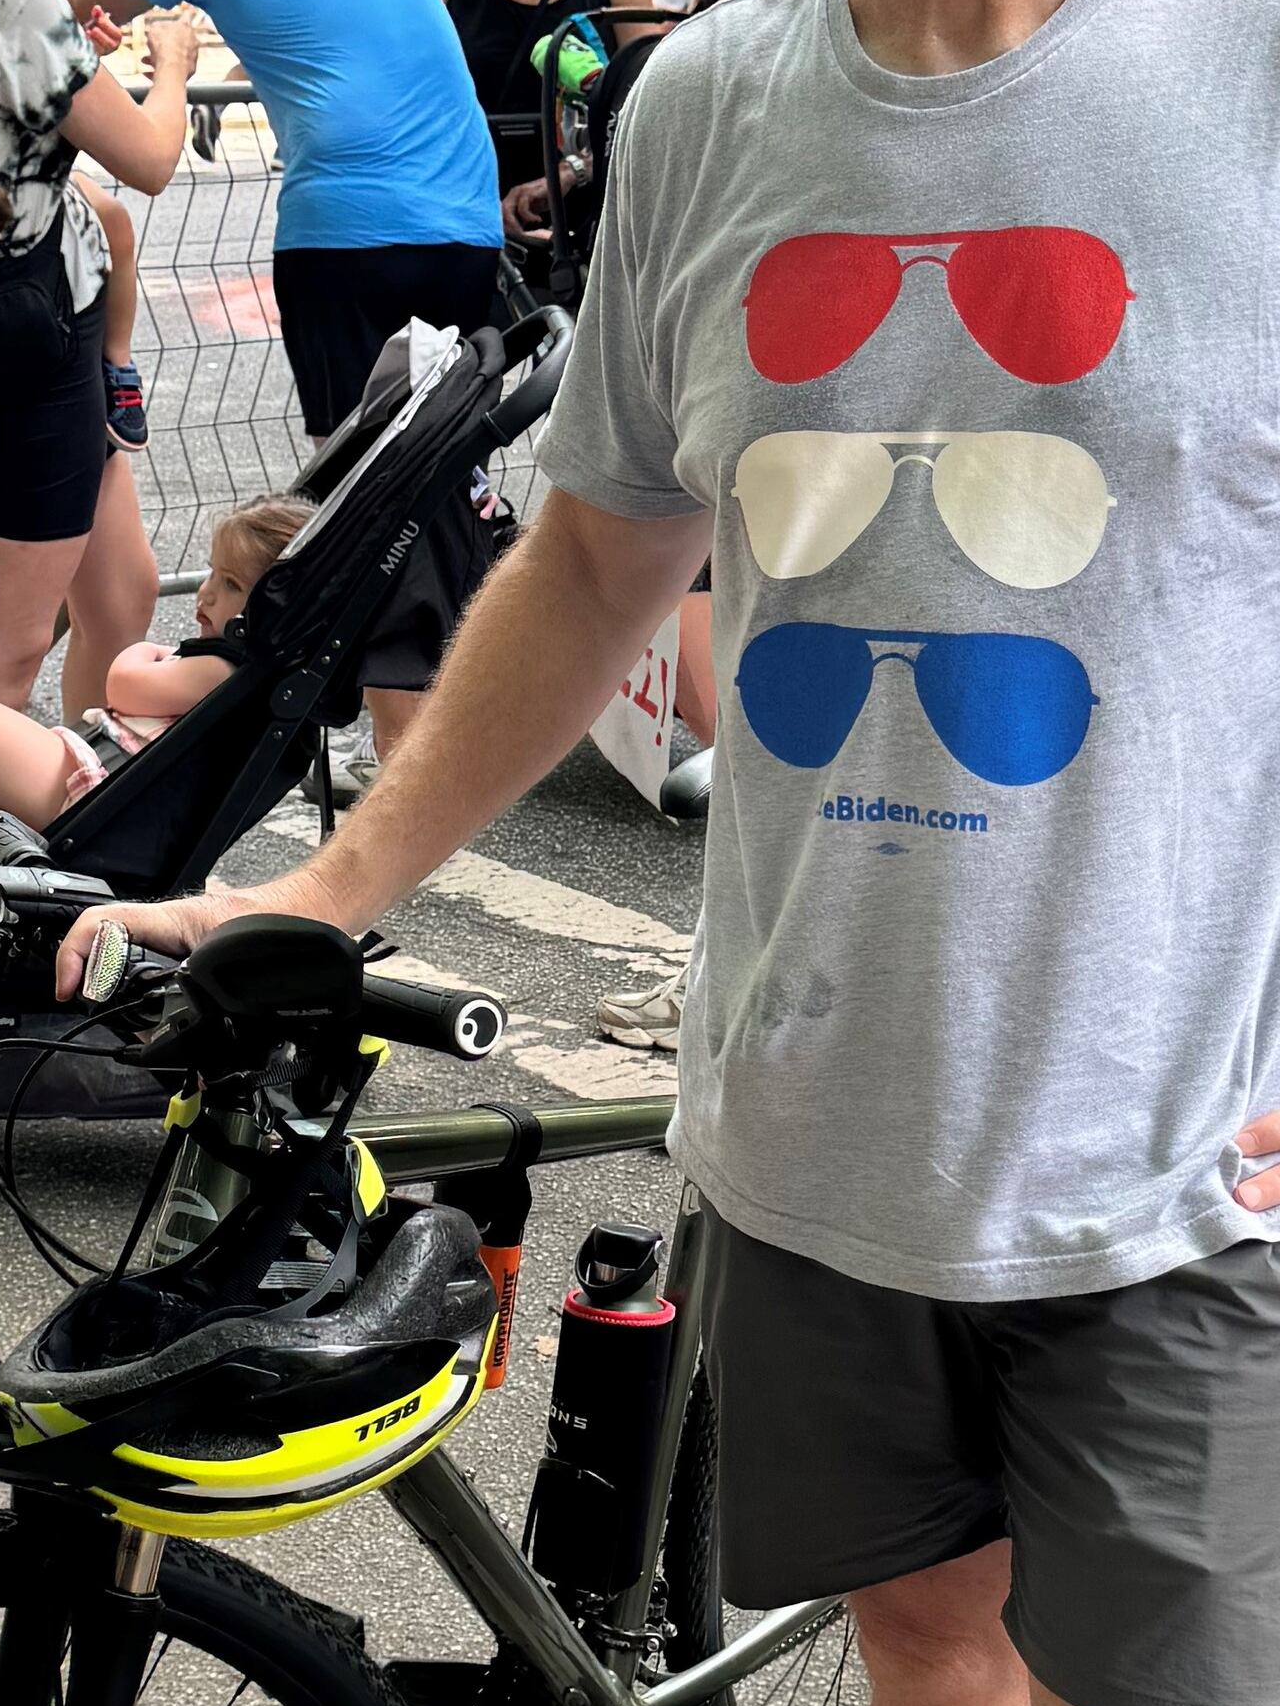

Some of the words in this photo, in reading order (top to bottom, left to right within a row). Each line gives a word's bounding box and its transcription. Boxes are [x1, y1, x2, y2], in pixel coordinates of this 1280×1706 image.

[379, 519, 420, 576] MINU
[819, 795, 988, 833] eBiden.com
[492, 1267, 516, 1368] KRYPTONITE
[353, 1394, 423, 1443] BELL
